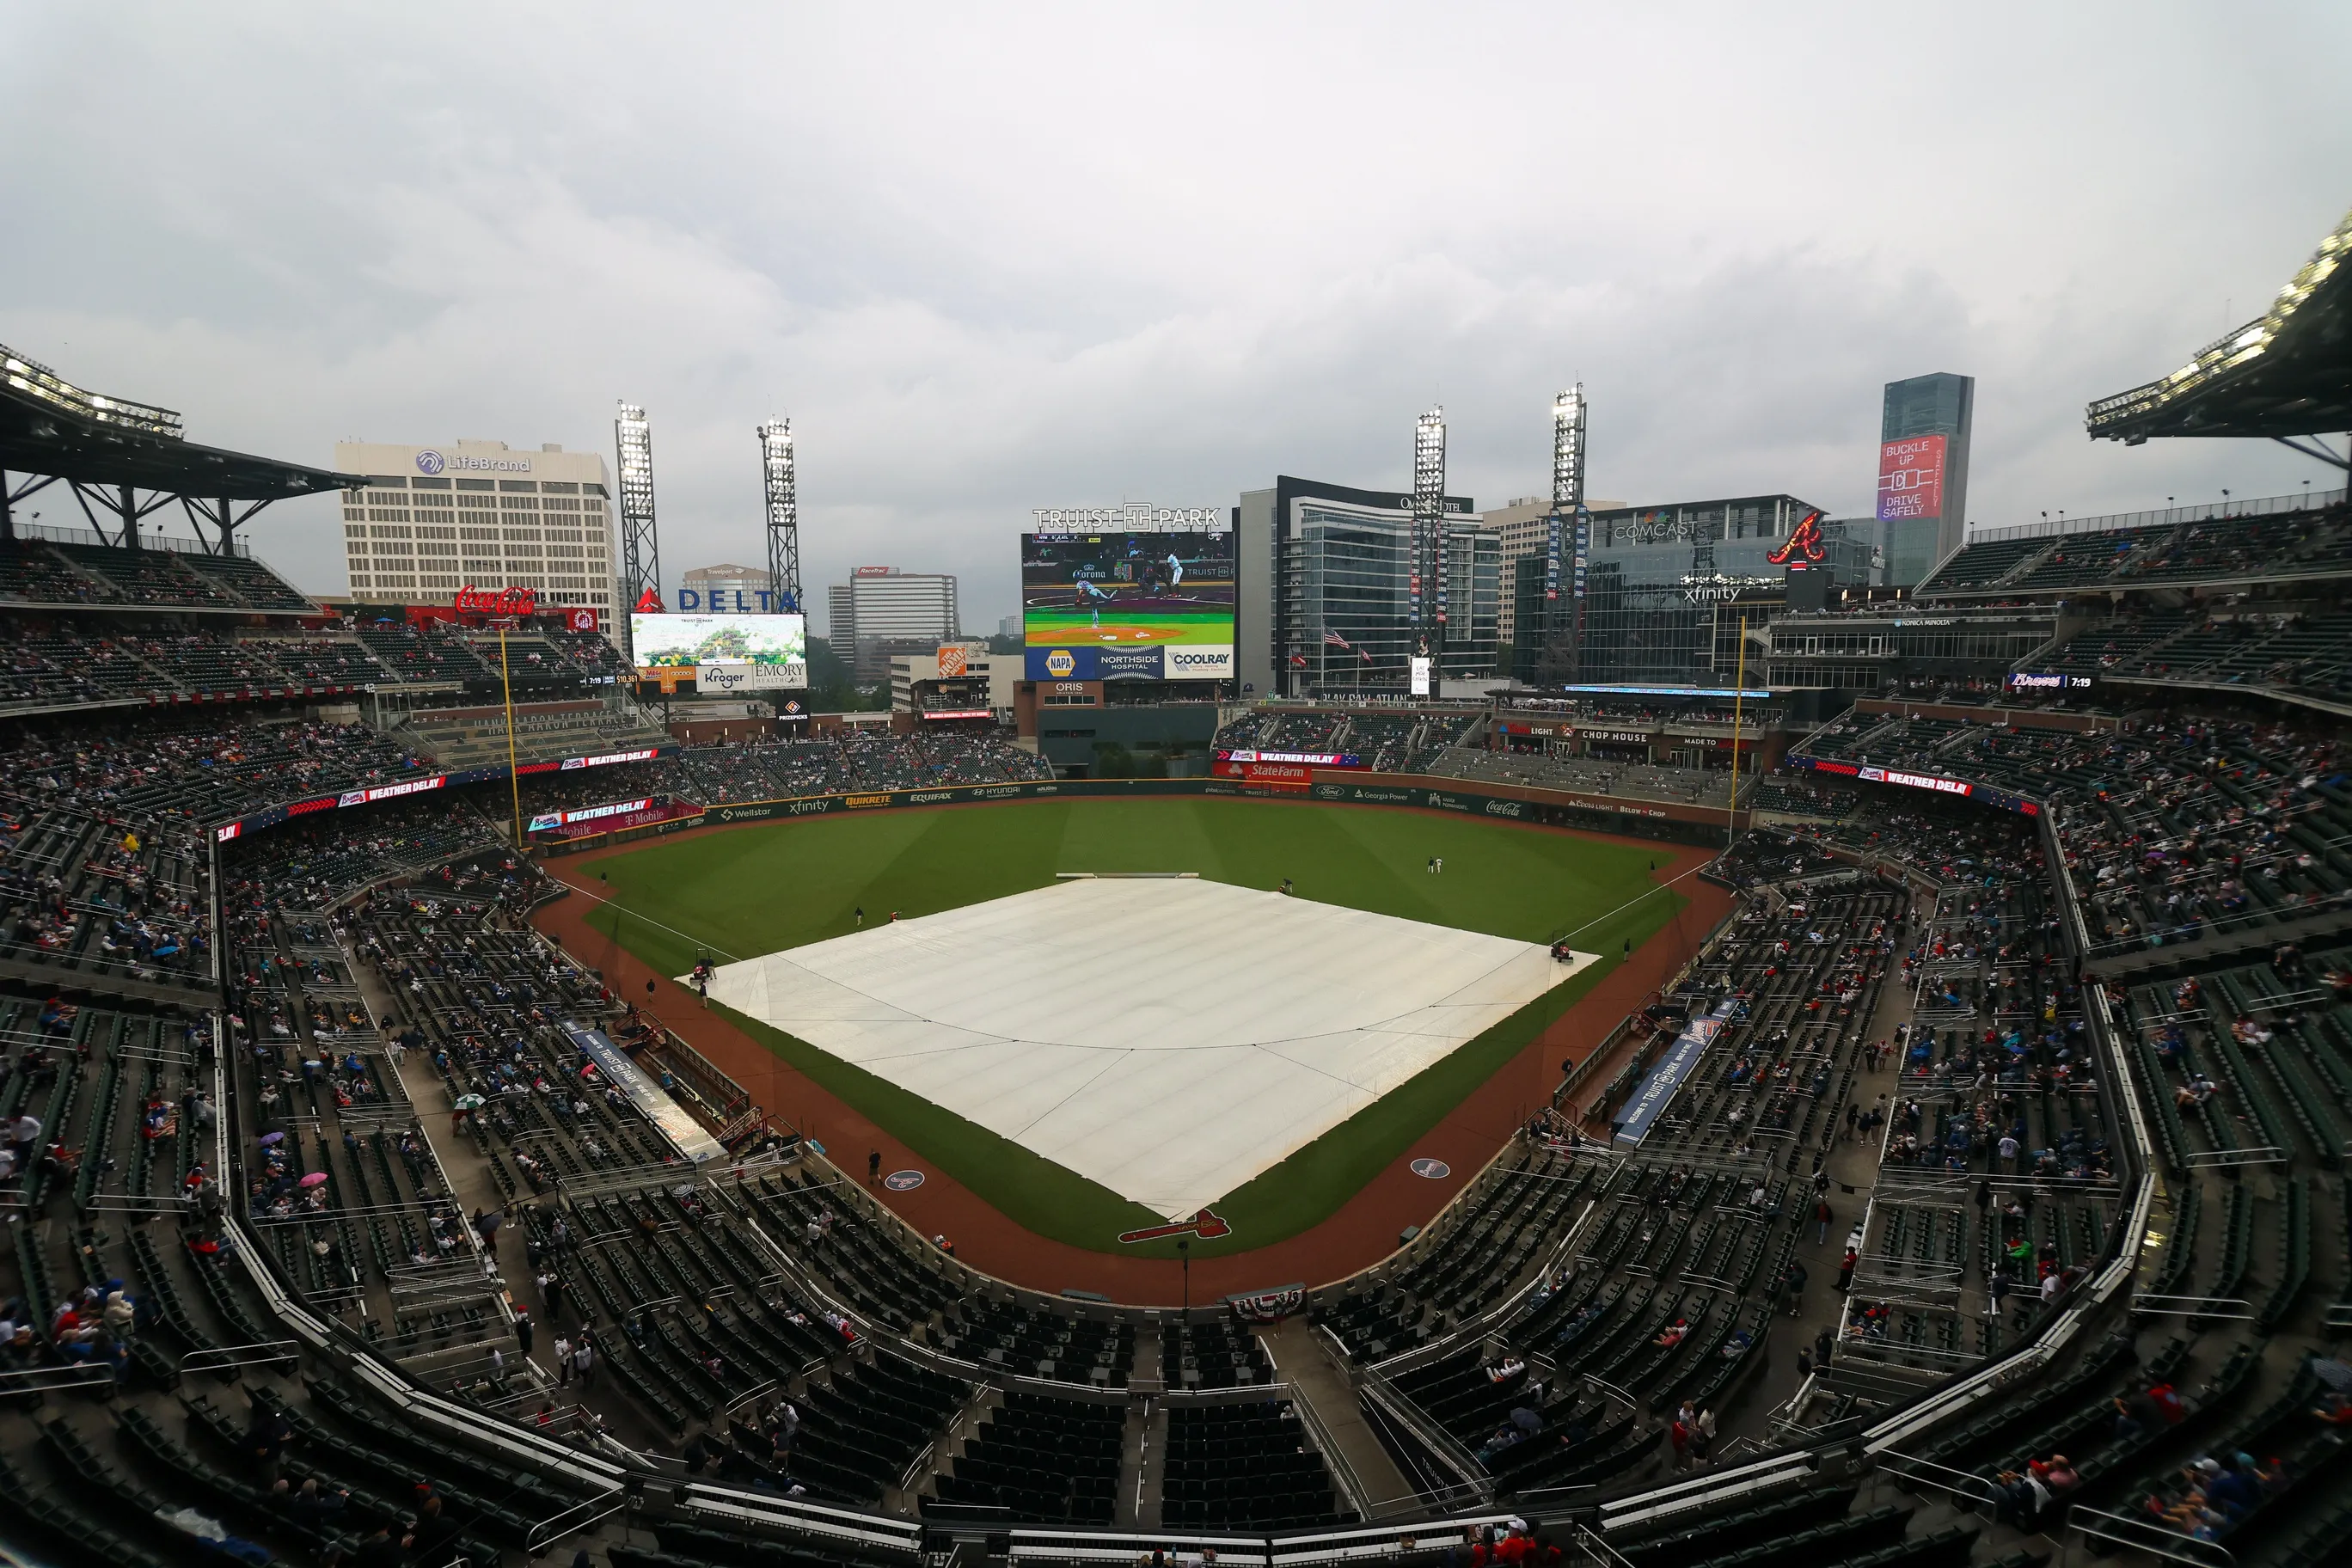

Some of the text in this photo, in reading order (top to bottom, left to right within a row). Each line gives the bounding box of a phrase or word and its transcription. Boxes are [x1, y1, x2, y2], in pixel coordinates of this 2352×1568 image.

[1887, 441, 1929, 456] BUCKLE
[447, 456, 530, 472] LifeBrand
[1899, 455, 1914, 465] UP
[1887, 493, 1921, 507] DRIVE
[1032, 508, 1220, 528] TRUIST PARK
[1883, 505, 1924, 518] SAFELY
[1614, 521, 1697, 539] COMCAST
[678, 589, 799, 610] DELTA
[1685, 585, 1741, 603] xfinity
[939, 647, 965, 676] HOME
[1050, 658, 1071, 670] NAPA
[1173, 653, 1229, 665] COOLRAY
[756, 665, 804, 677] EMORY
[950, 658, 965, 676] DEPOT
[705, 668, 744, 689] Kroger
[2012, 674, 2091, 687] Braves 7:19
[364, 683, 375, 693] 42
[1056, 683, 1083, 691] ORIS
[516, 714, 568, 732] AARON
[560, 710, 626, 727] TERRACE
[1583, 731, 1646, 742] CHOP HOUSE
[588, 753, 627, 765] WEATHER
[627, 750, 652, 761] DELAY
[1260, 753, 1302, 763] WEATHER
[1304, 755, 1334, 763] DELAY
[370, 783, 412, 800] WEATHER
[413, 778, 439, 792] DELAY
[1888, 772, 1935, 789] WEATHER
[1936, 780, 1967, 794] DELAY
[910, 793, 952, 802] EQUIFAX
[1321, 787, 1338, 795] Ford
[1364, 792, 1388, 800] Georgia
[789, 800, 829, 815] xfinity
[846, 795, 891, 805] QUIKRETE
[567, 805, 615, 822] WEATHER
[616, 799, 646, 814] DELAY
[635, 810, 664, 824] Mobile
[735, 808, 771, 818] Wellstar
[599, 1049, 622, 1066] TRUIST
[619, 1069, 640, 1083] PARK
[1626, 1107, 1645, 1124] WELCOME
[1642, 1081, 1666, 1100] TRUIST
[1665, 1062, 1681, 1077] PARK
[1422, 1457, 1444, 1488] TRUIST
